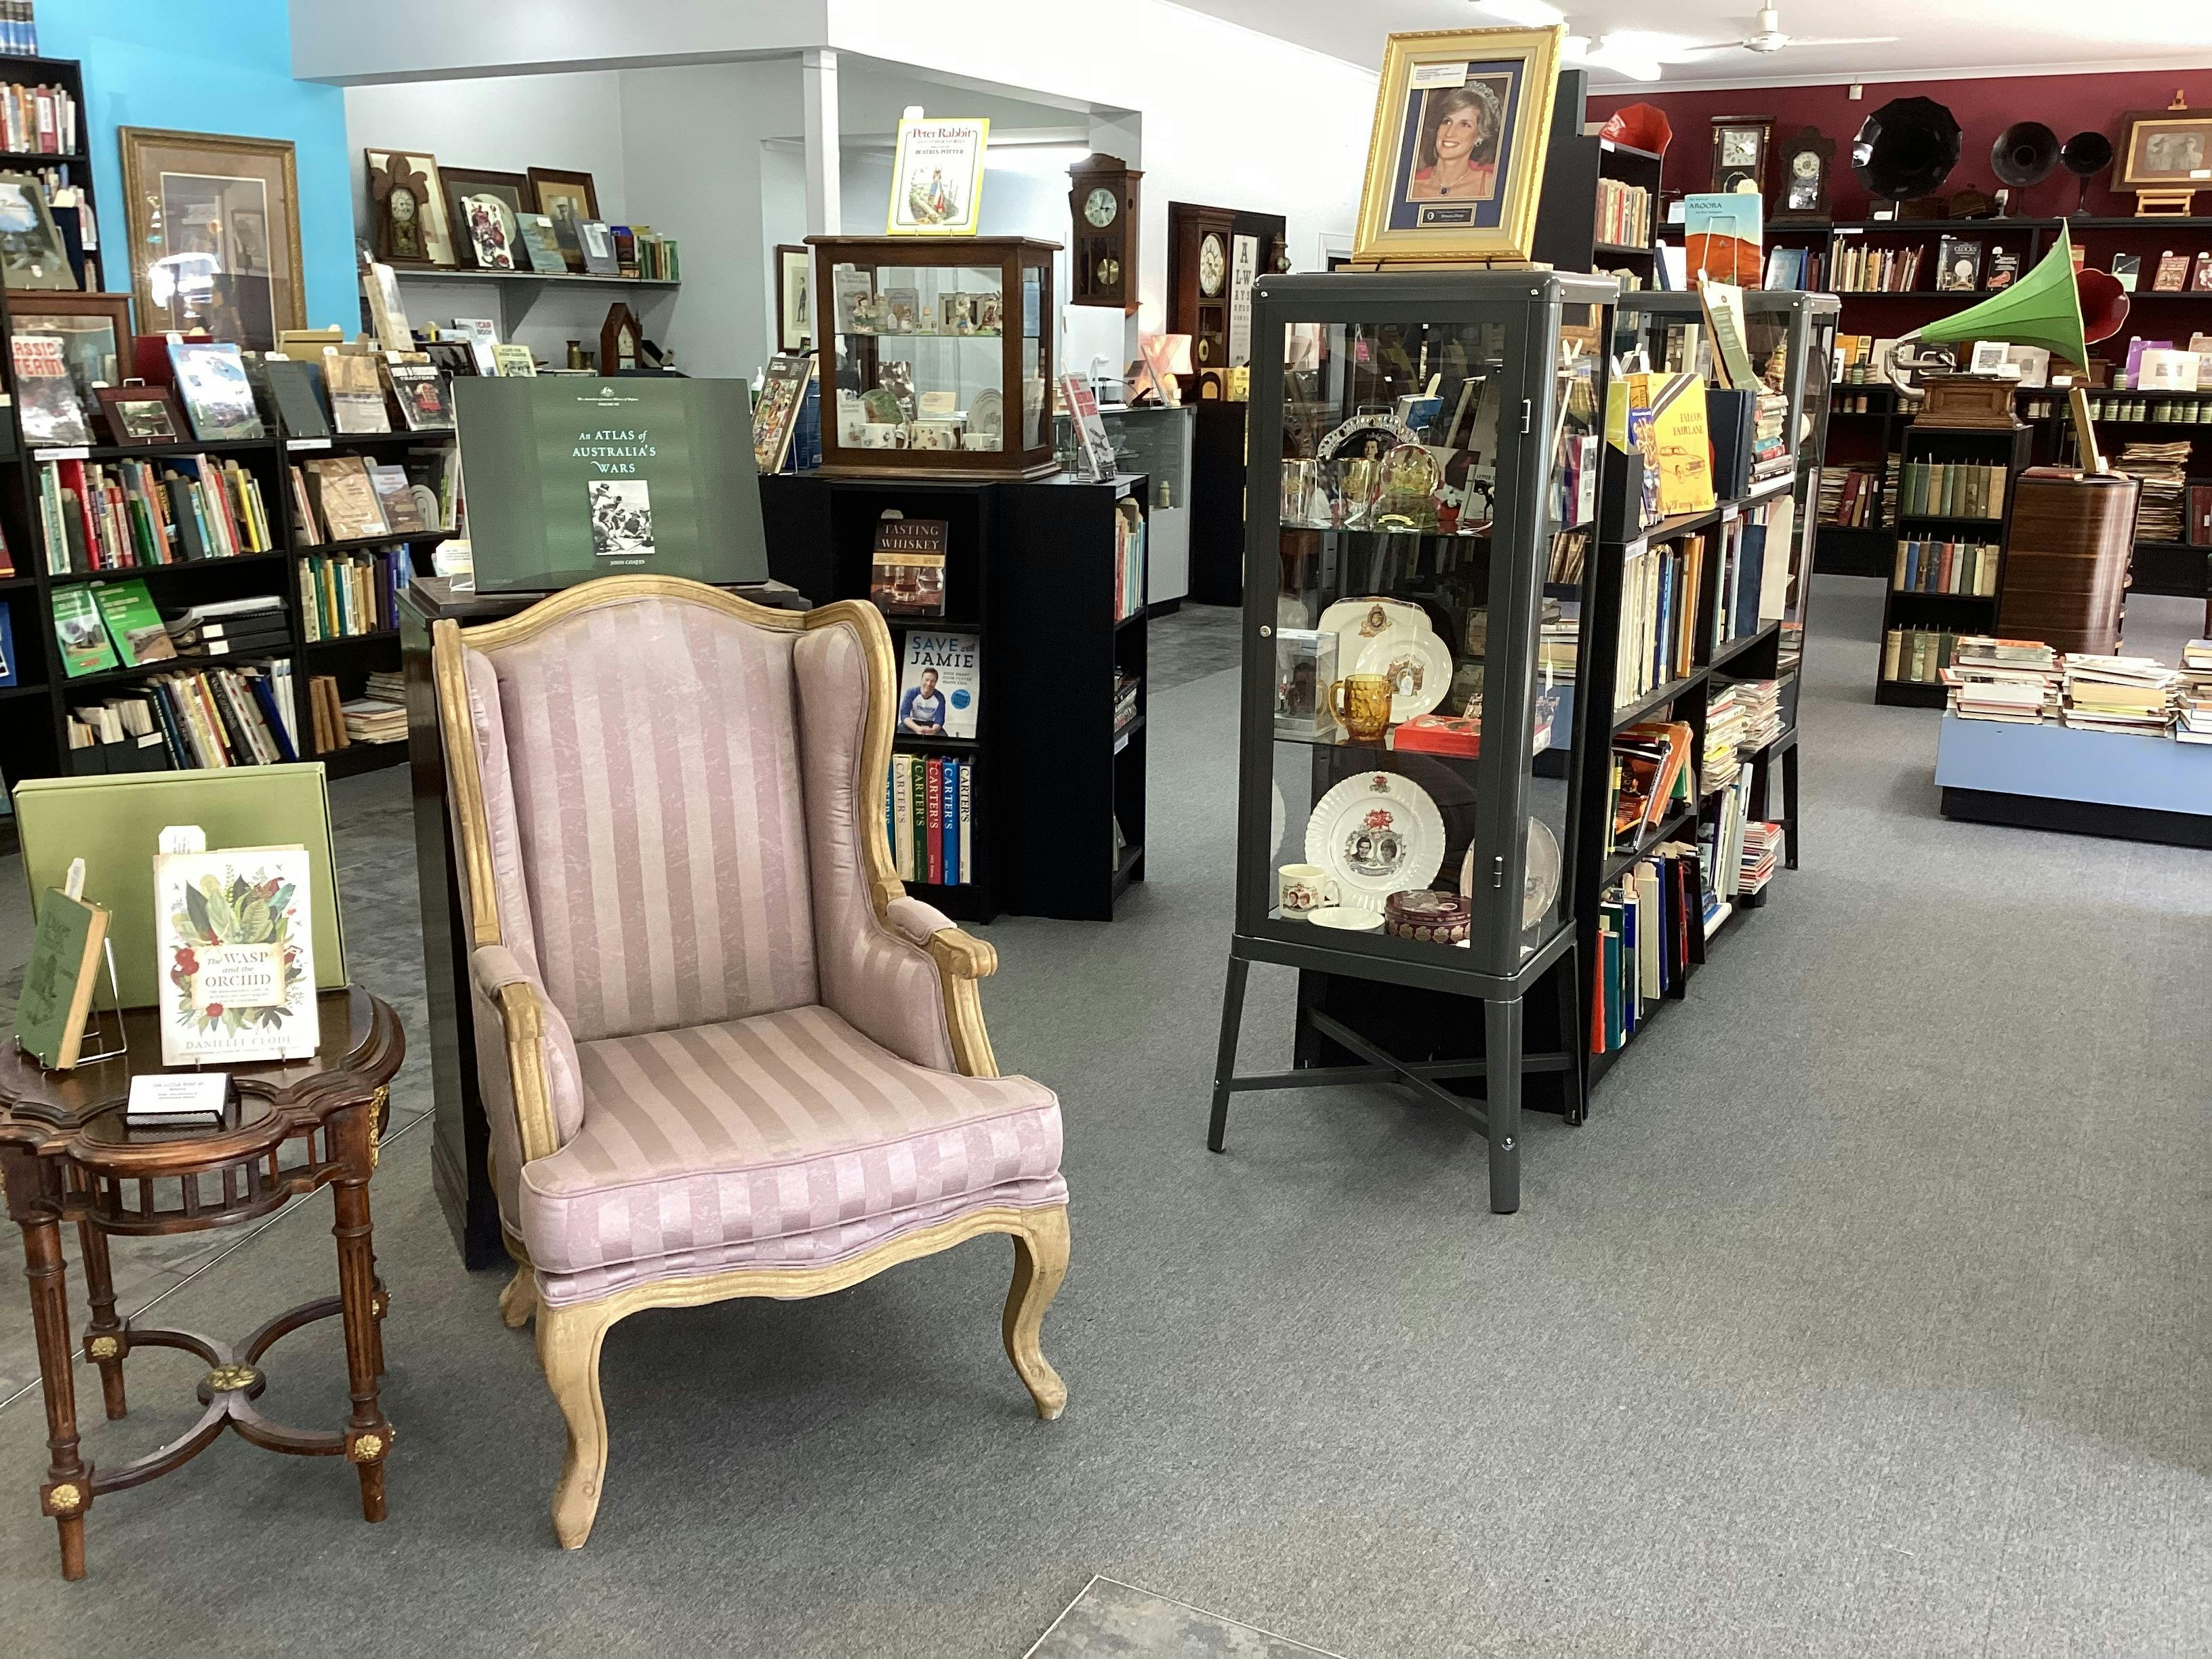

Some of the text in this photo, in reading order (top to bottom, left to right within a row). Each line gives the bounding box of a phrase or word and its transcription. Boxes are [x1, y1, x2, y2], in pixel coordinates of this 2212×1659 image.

[912, 127, 972, 138] Peter Rabbit
[1680, 412, 1702, 423] FALCON
[579, 430, 648, 443] An ATLAS of
[1673, 425, 1704, 436] FAIRLANE
[572, 445, 657, 457] AUSTRALIA'S
[590, 461, 636, 474] WARS
[883, 525, 939, 536] TASTING
[882, 538, 940, 550] WHISKEY
[912, 636, 960, 652] SAVE
[911, 651, 974, 668] JAMIE
[895, 762, 906, 824] CARTER'S
[914, 765, 925, 827] CARTER'S
[929, 767, 939, 830] CARTER'S
[944, 767, 954, 830] CARTER'S
[960, 768, 970, 823] CARTER'S
[224, 951, 268, 964] WASP
[205, 974, 271, 987] ORCHID
[185, 1038, 245, 1050] DANIELLE
